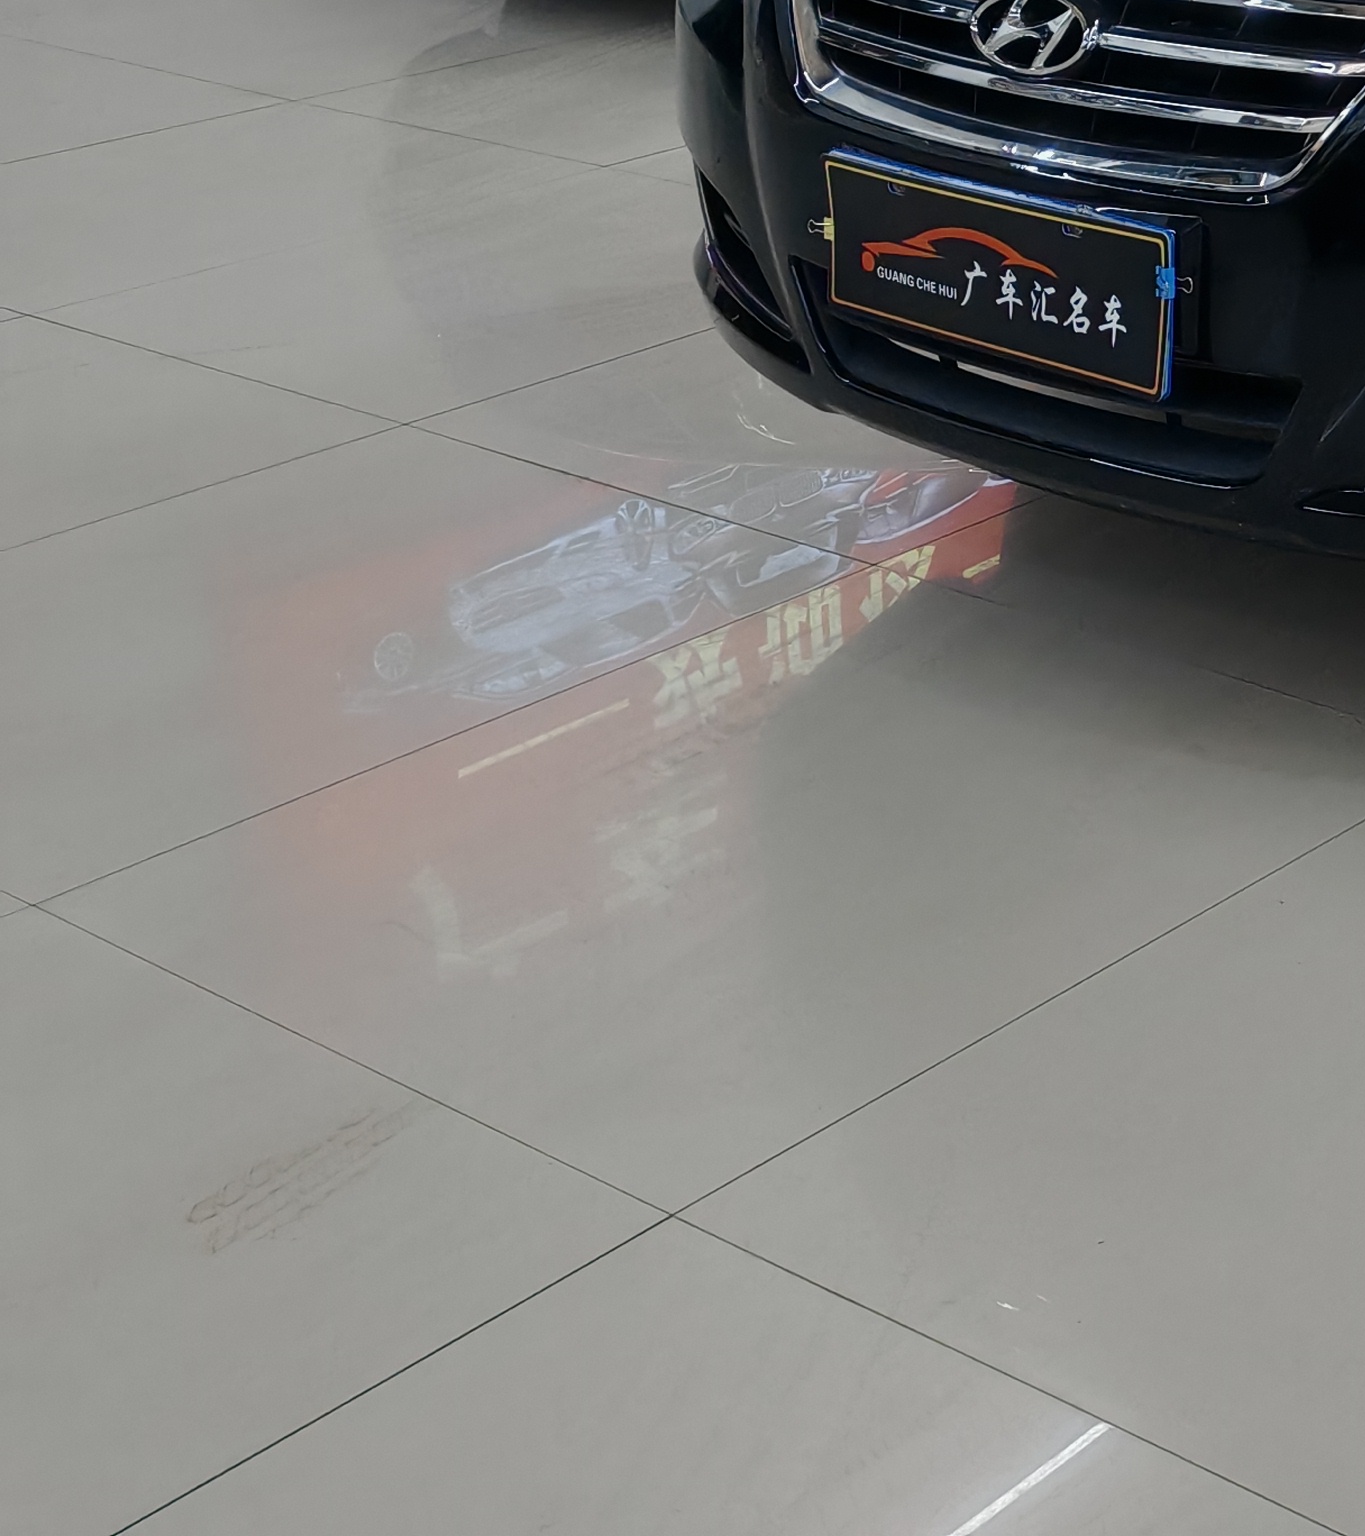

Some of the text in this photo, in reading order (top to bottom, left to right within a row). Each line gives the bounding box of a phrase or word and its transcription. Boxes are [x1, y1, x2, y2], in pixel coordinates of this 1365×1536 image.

[877, 265, 958, 300] GUANG CHE HUI
[960, 260, 1128, 349] 广车汇名车
